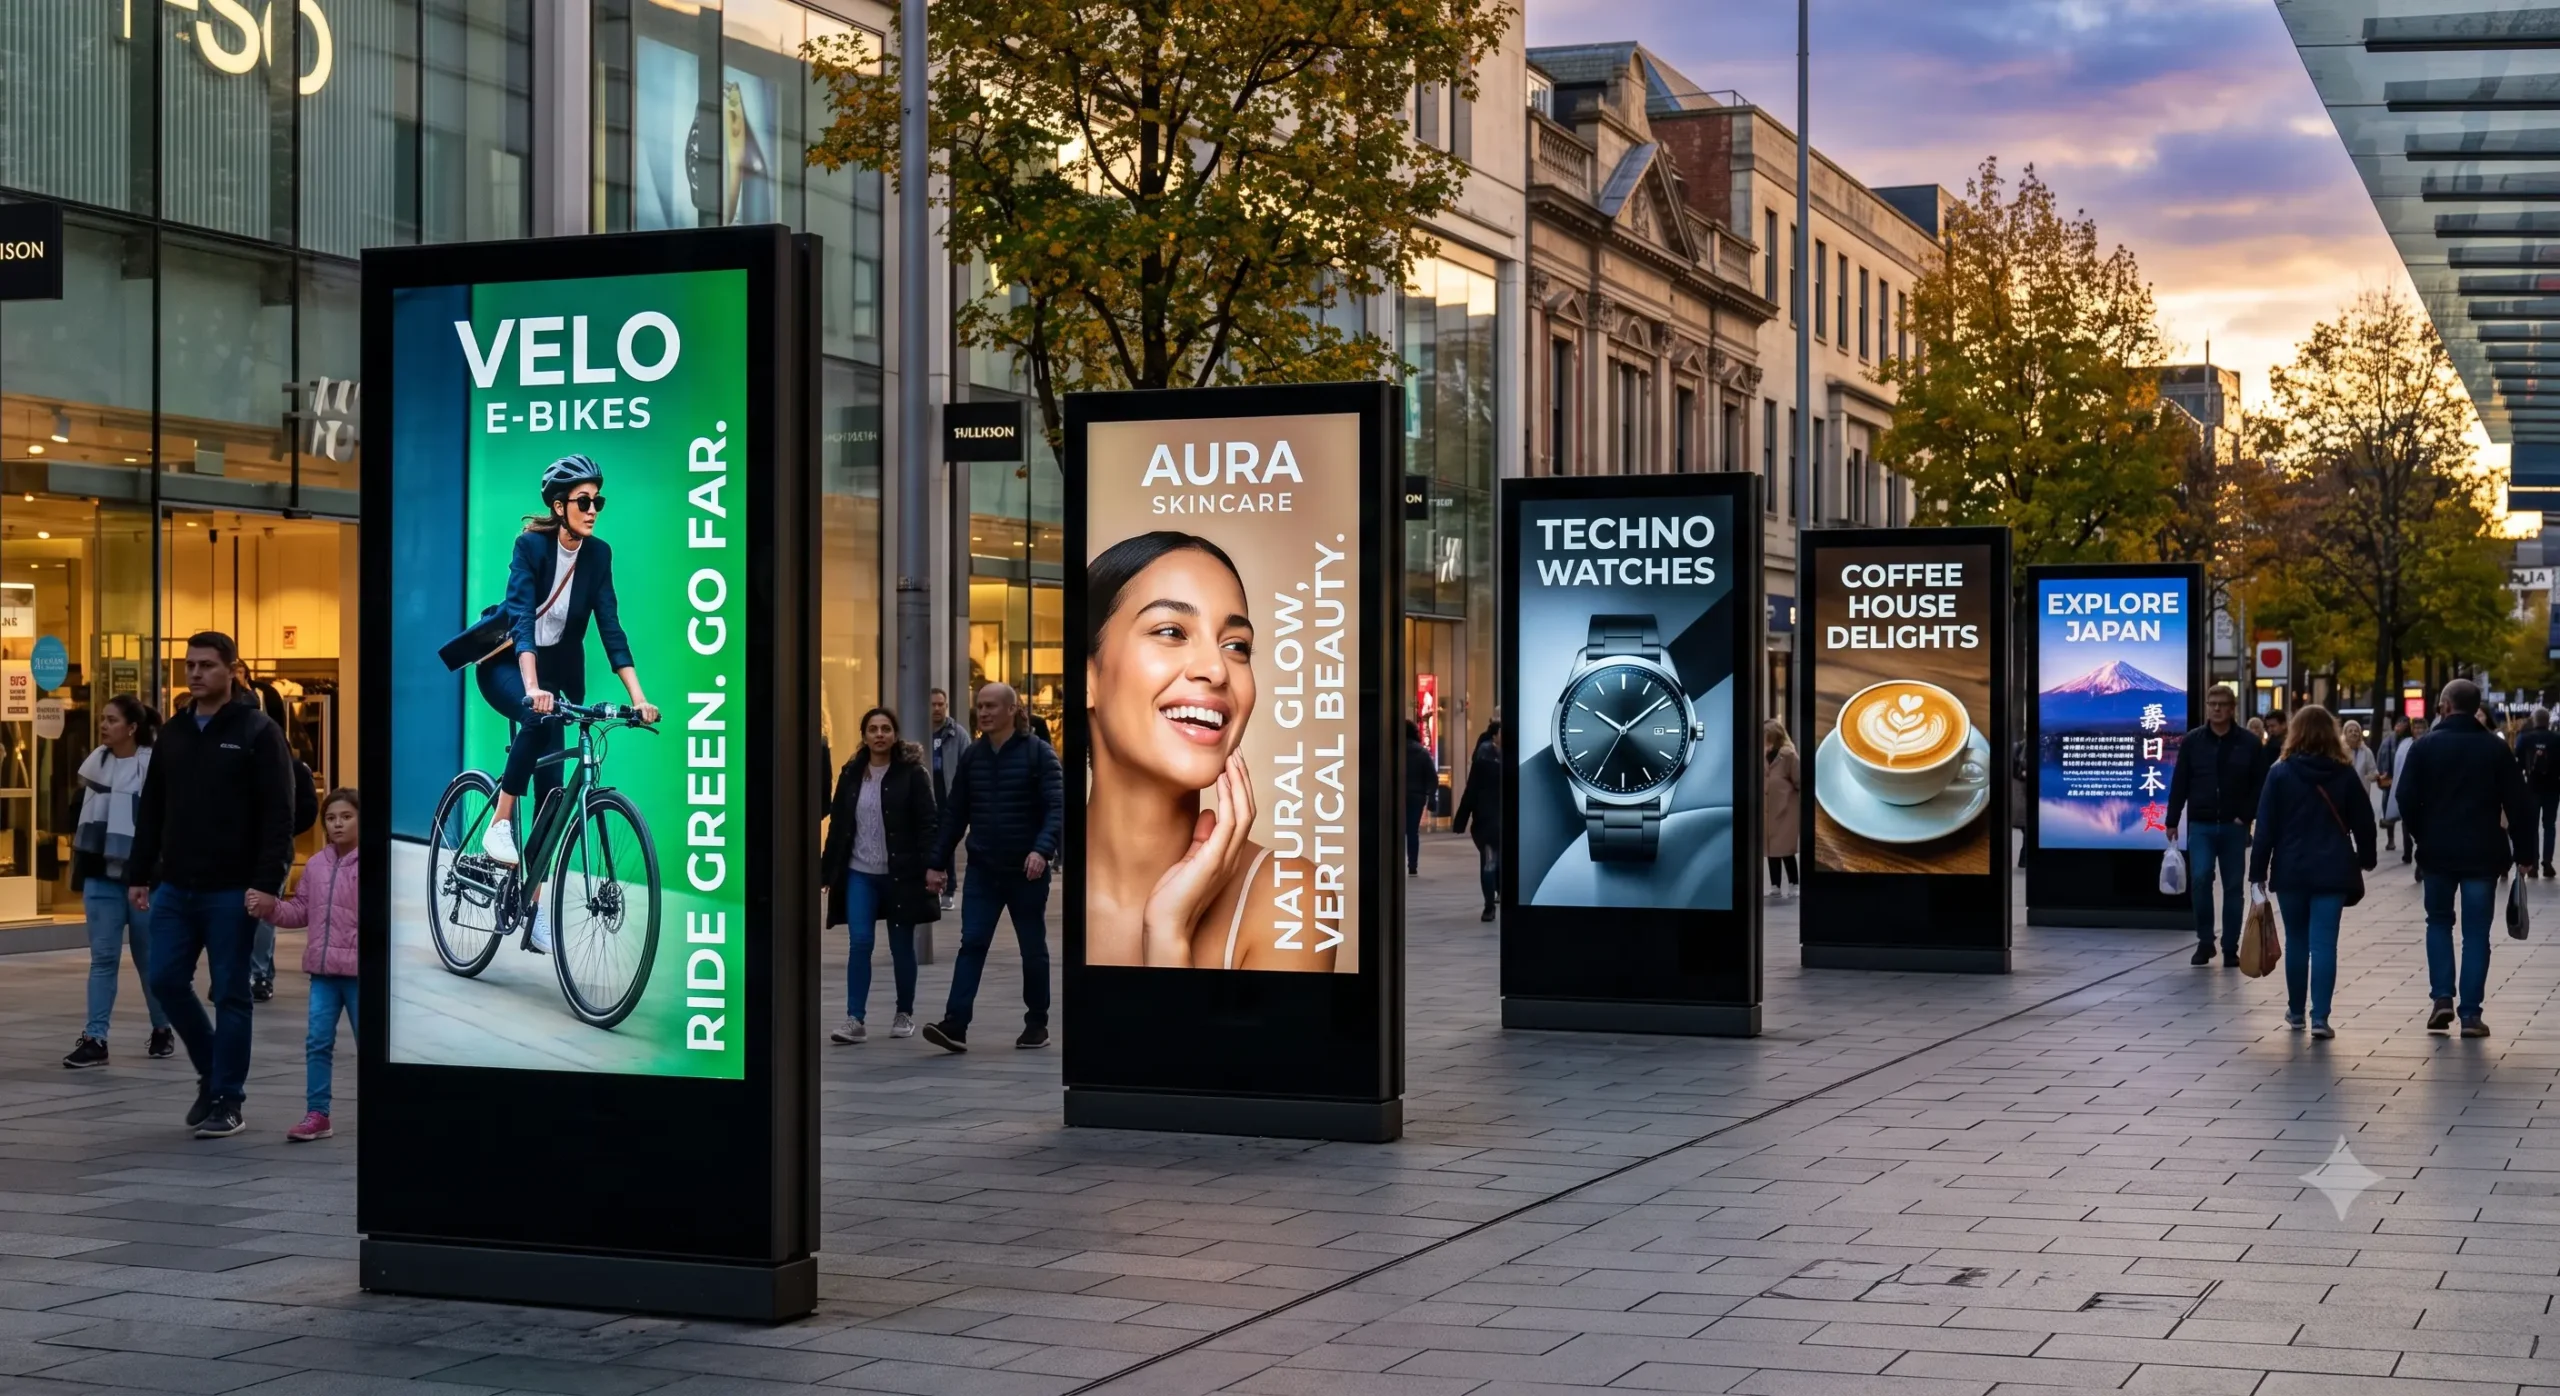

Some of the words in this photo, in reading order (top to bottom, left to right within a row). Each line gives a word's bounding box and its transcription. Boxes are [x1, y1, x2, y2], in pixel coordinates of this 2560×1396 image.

[454, 311, 681, 389] VELO
[486, 397, 651, 434] E-BIKES
[687, 420, 728, 548] FAR.
[1141, 440, 1304, 488] AURA
[1151, 492, 1293, 515] SKINCARE
[1536, 515, 1716, 551] TECHNO
[1536, 556, 1716, 587] WATCHES
[1840, 562, 1964, 588] COFFEE
[687, 568, 727, 656] GO
[1314, 533, 1346, 720] BEAUTY.
[1848, 594, 1957, 619] HOUSE
[2047, 591, 2180, 616] EXPLORE
[1274, 581, 1310, 729] GLOW,
[1826, 624, 1980, 650] DELIGHTS
[2065, 619, 2161, 643] JAPAN
[687, 675, 727, 892] GREEN.
[1274, 742, 1304, 950] NATURAL
[1314, 734, 1345, 952] VERTICAL
[687, 911, 726, 1051] RIDE
